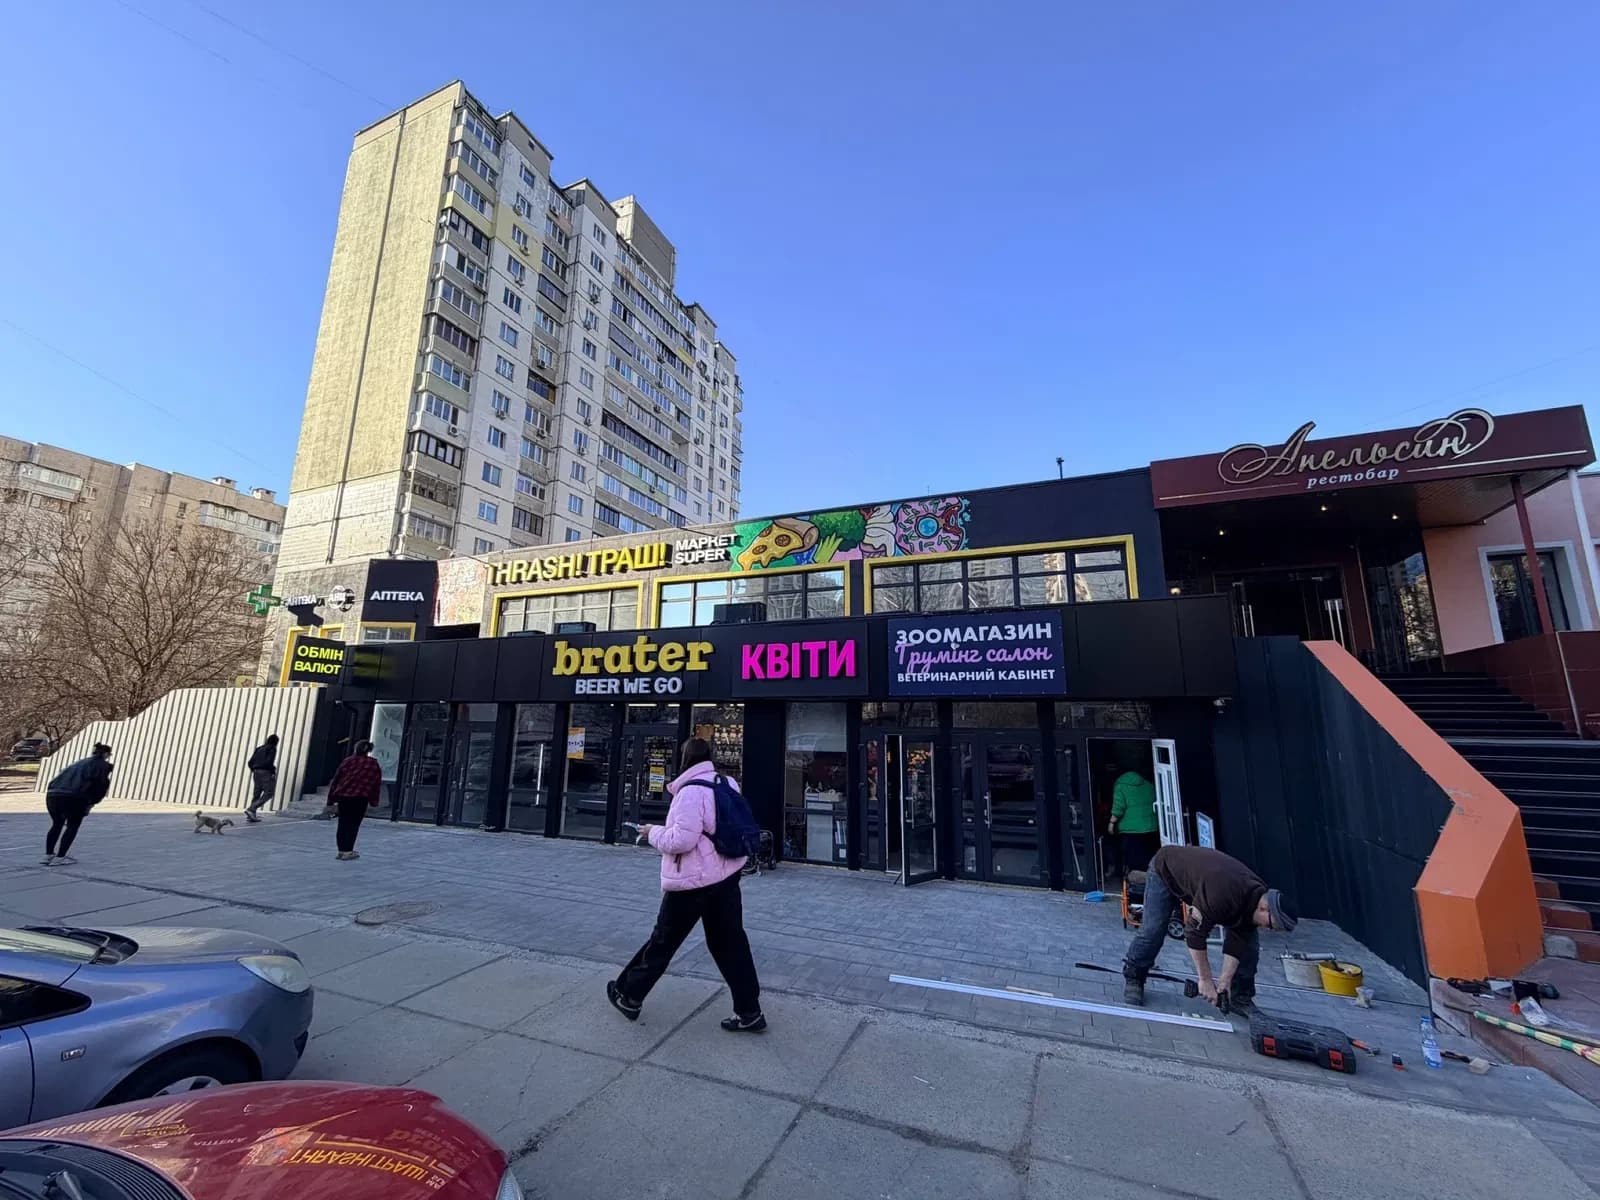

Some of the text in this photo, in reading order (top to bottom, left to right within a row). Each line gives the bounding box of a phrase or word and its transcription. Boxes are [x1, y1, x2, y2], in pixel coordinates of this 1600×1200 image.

[1218, 407, 1495, 486] Апельсин
[1306, 467, 1400, 489] рестобар
[487, 542, 667, 585] THRASH! ТРАШ!
[675, 549, 726, 564] SUPER
[370, 590, 424, 602] АПТЕКА
[896, 622, 1052, 645] ЗООМАГАЗИН
[297, 645, 344, 661] ОБМІН
[553, 635, 714, 676] brater
[741, 639, 857, 680] КВІТИ
[986, 645, 1053, 662] салон
[294, 660, 342, 675] ВАЛЮТ
[897, 669, 1056, 683] ВЕТЕРИНАРНИЙ КАБІНЕТ
[575, 676, 683, 695] BEER WE GO
